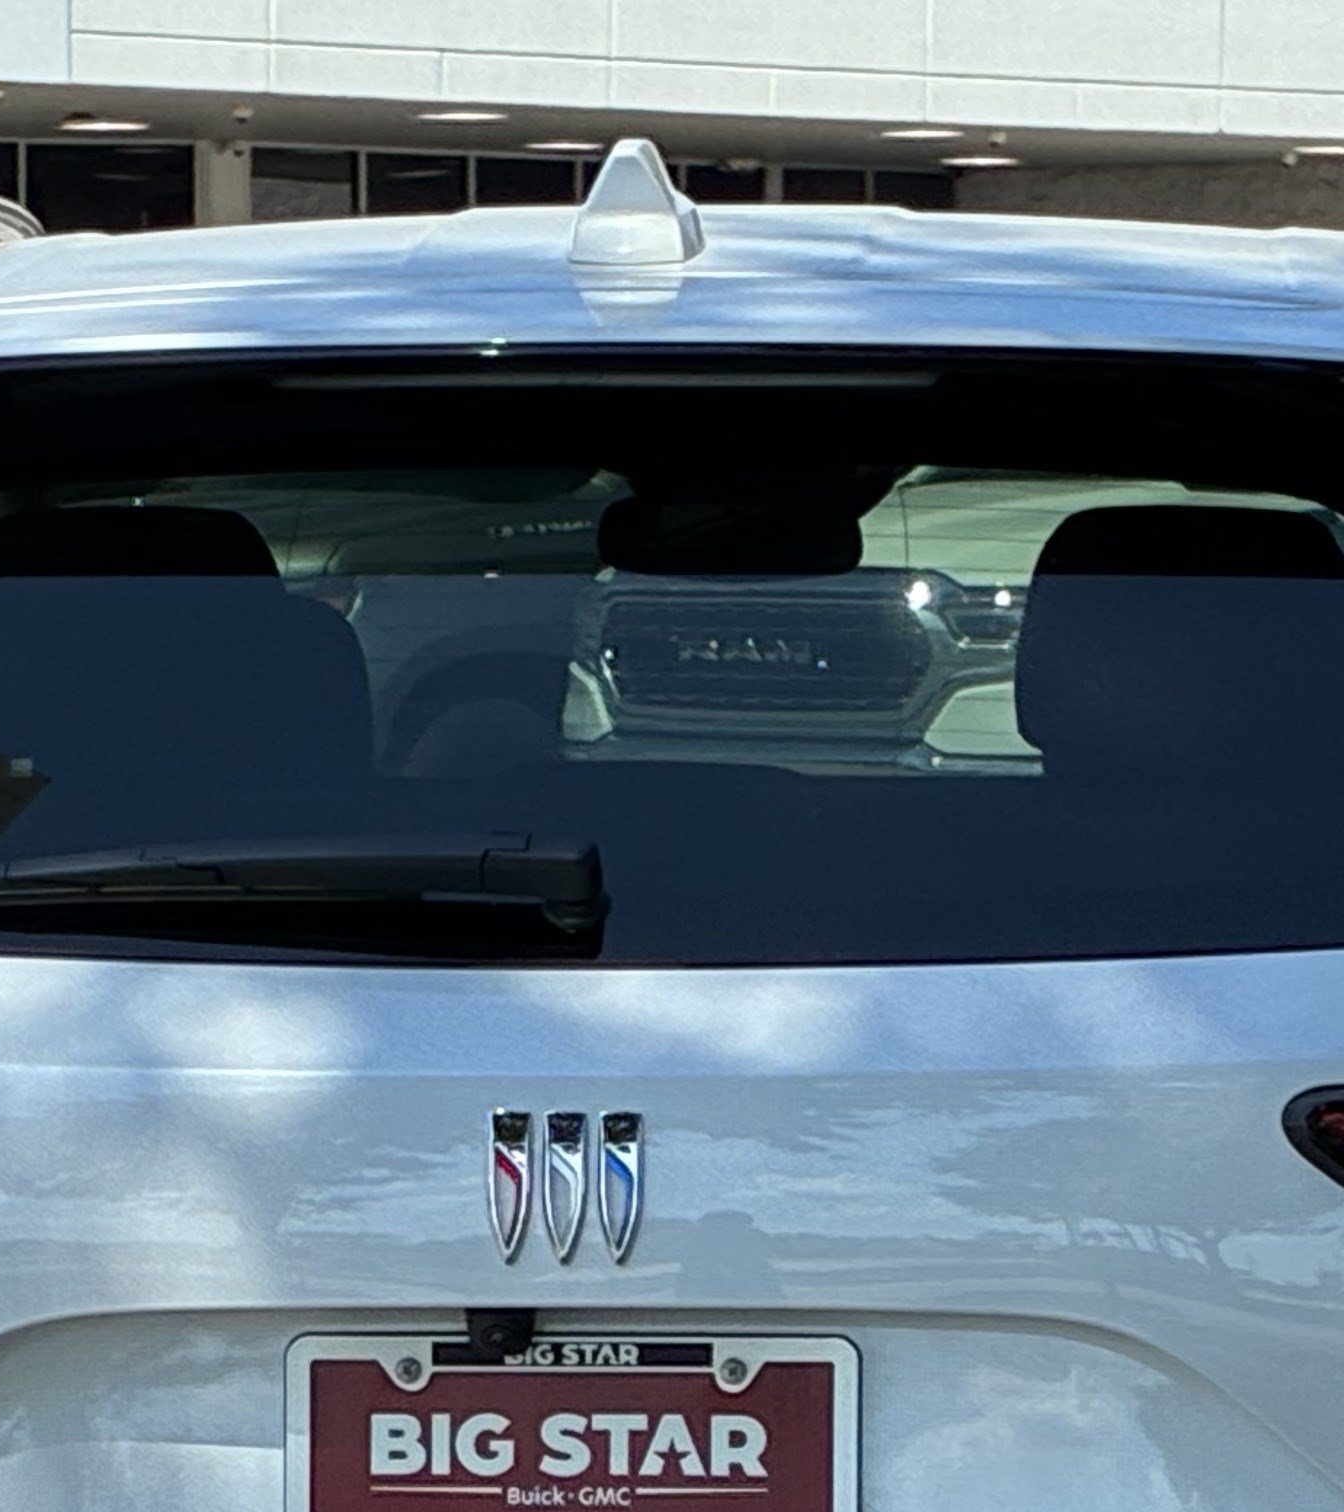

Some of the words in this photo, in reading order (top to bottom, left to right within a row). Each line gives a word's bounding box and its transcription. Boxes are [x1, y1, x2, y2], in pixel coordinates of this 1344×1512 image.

[561, 1344, 639, 1365] STAR
[370, 1413, 515, 1477] BIG
[540, 1413, 769, 1478] STAR
